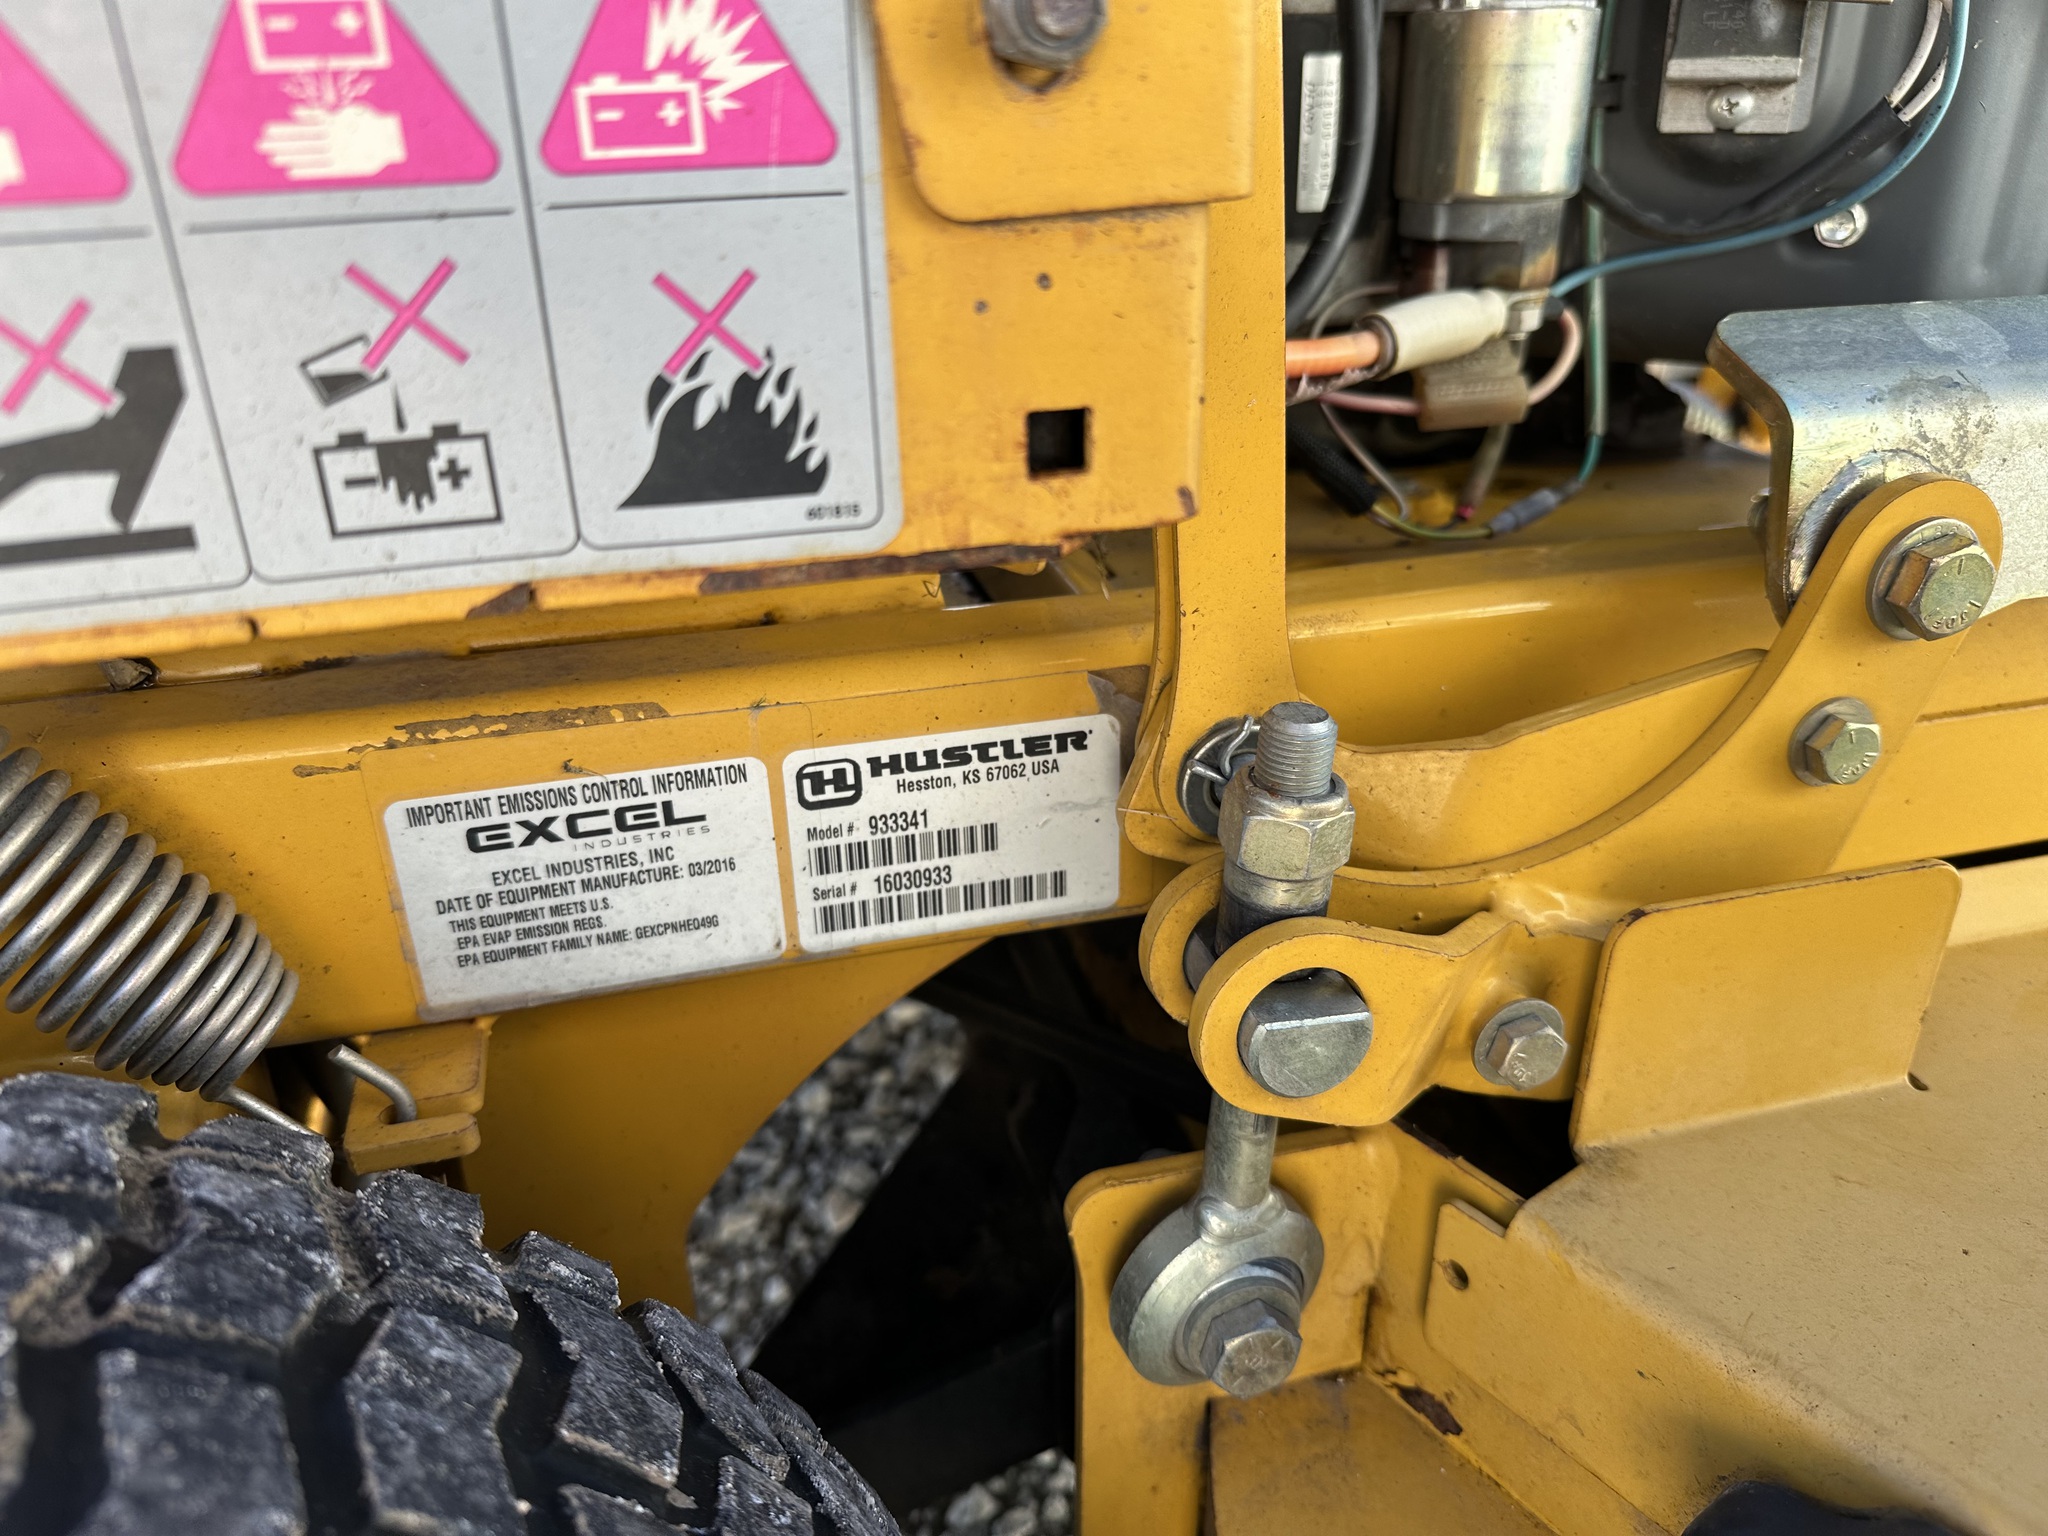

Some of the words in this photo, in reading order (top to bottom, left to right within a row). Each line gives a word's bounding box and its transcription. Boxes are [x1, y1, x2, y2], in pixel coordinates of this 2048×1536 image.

[866, 730, 1088, 778] HUSTLER
[896, 775, 957, 794] Hesston,
[962, 768, 981, 785] KS
[986, 763, 1026, 782] 67062
[1032, 758, 1060, 776] USA
[405, 796, 493, 828] IMPORTANT
[497, 784, 578, 816] EMISSIONS
[581, 776, 649, 805] CONTROL
[651, 763, 749, 796] INFORMATION
[466, 800, 707, 854] EXCEL
[573, 825, 711, 852] INDUSTRIES
[806, 823, 843, 842] Model
[847, 822, 855, 837] #
[868, 808, 928, 836] 933341
[491, 866, 542, 887] EXCEL
[545, 851, 645, 879] INDUSTRIES,
[648, 845, 676, 864] INC
[812, 883, 846, 901] Serial
[850, 882, 857, 896] #
[873, 864, 953, 894] 16030933
[436, 895, 473, 916] DATE
[475, 892, 494, 910] OF
[497, 880, 577, 907] EQUIPMENT
[580, 864, 685, 894] MANUFACTURE:
[687, 856, 737, 878] 03/2016
[448, 917, 477, 933] THIS
[479, 906, 546, 929] EQUIPMENT
[549, 900, 588, 918] MEETS
[590, 896, 614, 913] U.S.
[457, 935, 481, 950] EPA
[482, 929, 513, 946] EVAP
[515, 920, 570, 942] EMISSION
[573, 915, 608, 932] REGS.
[457, 953, 481, 968] EPA
[482, 942, 549, 965] EQUIPMENT
[551, 934, 594, 953] FAMILY
[596, 928, 633, 947] NAME:
